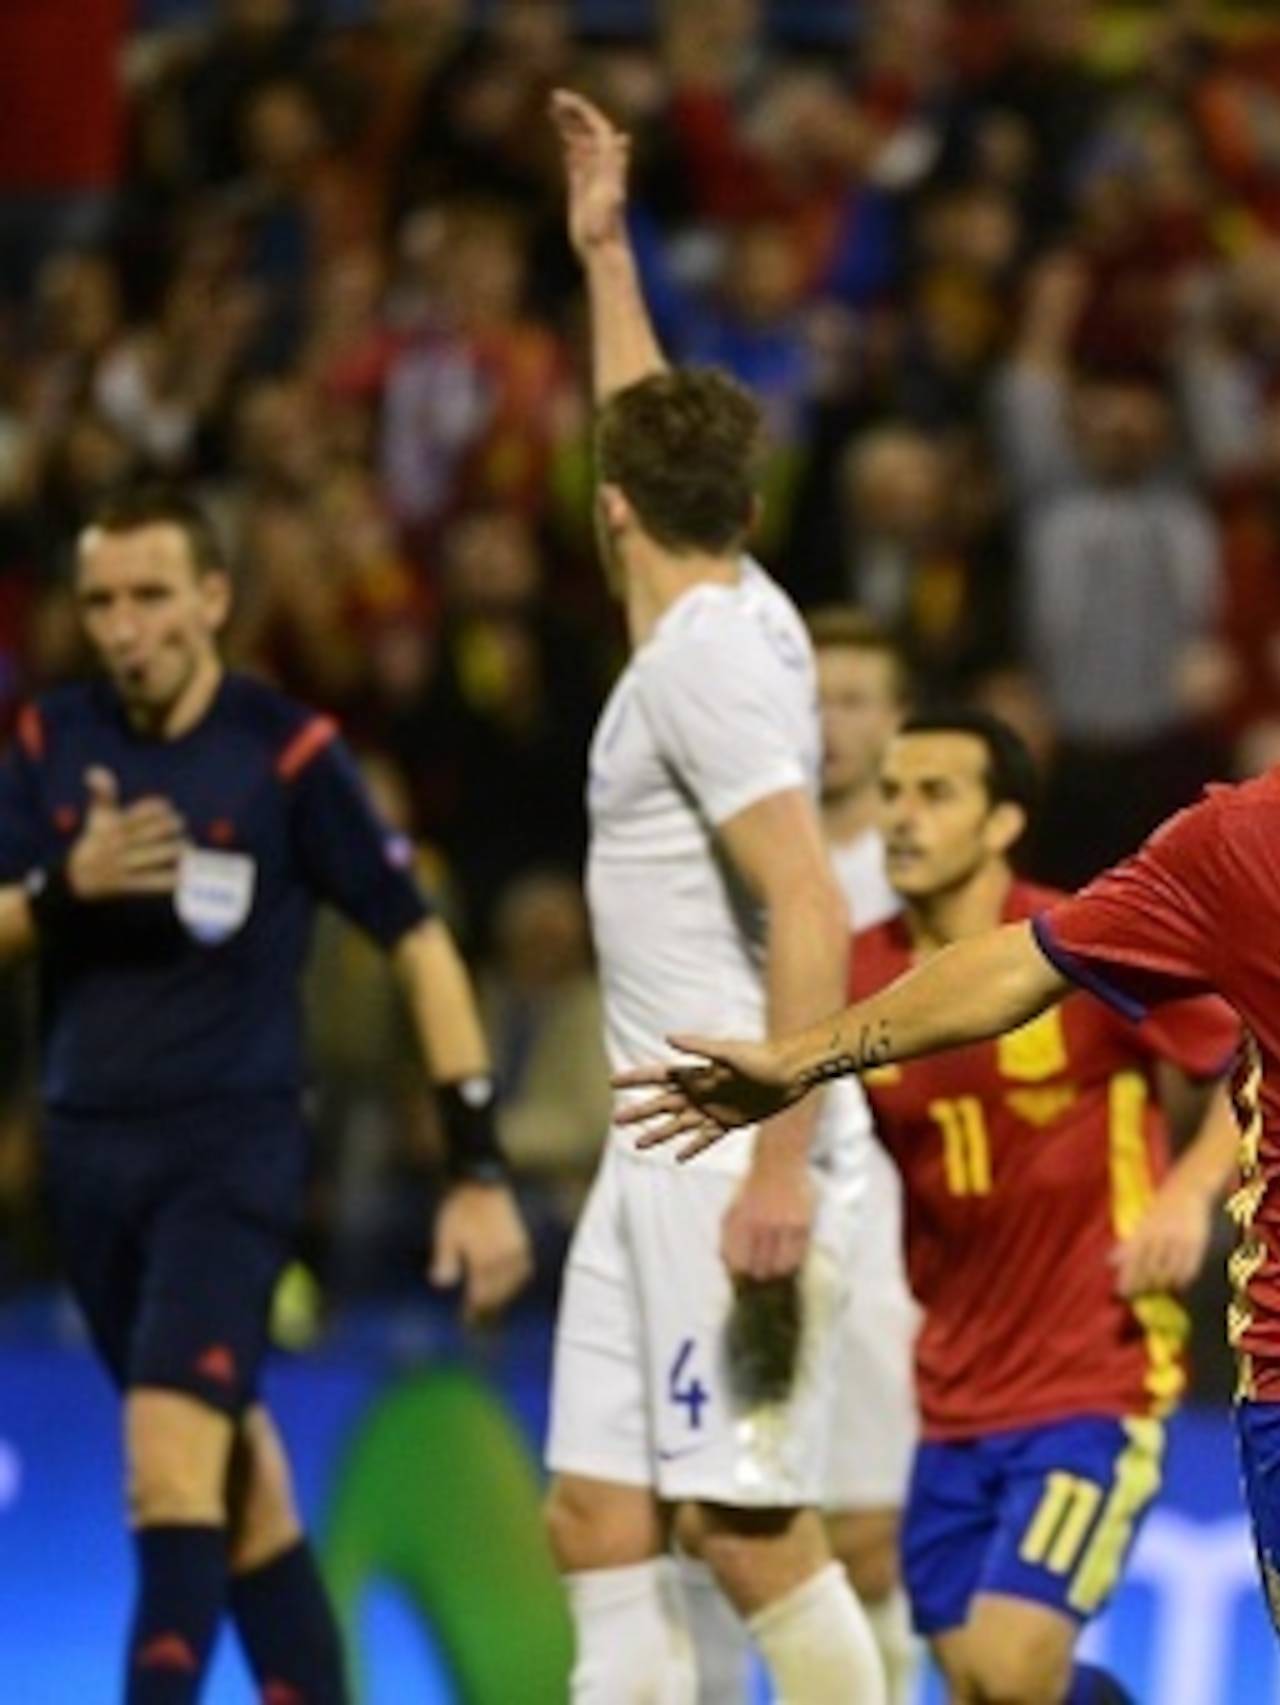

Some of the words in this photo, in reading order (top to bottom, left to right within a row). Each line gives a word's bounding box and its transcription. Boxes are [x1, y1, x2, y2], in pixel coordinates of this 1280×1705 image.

[927, 1094, 993, 1197] 11
[668, 1338, 710, 1430] 4
[1017, 1468, 1103, 1577] 11
